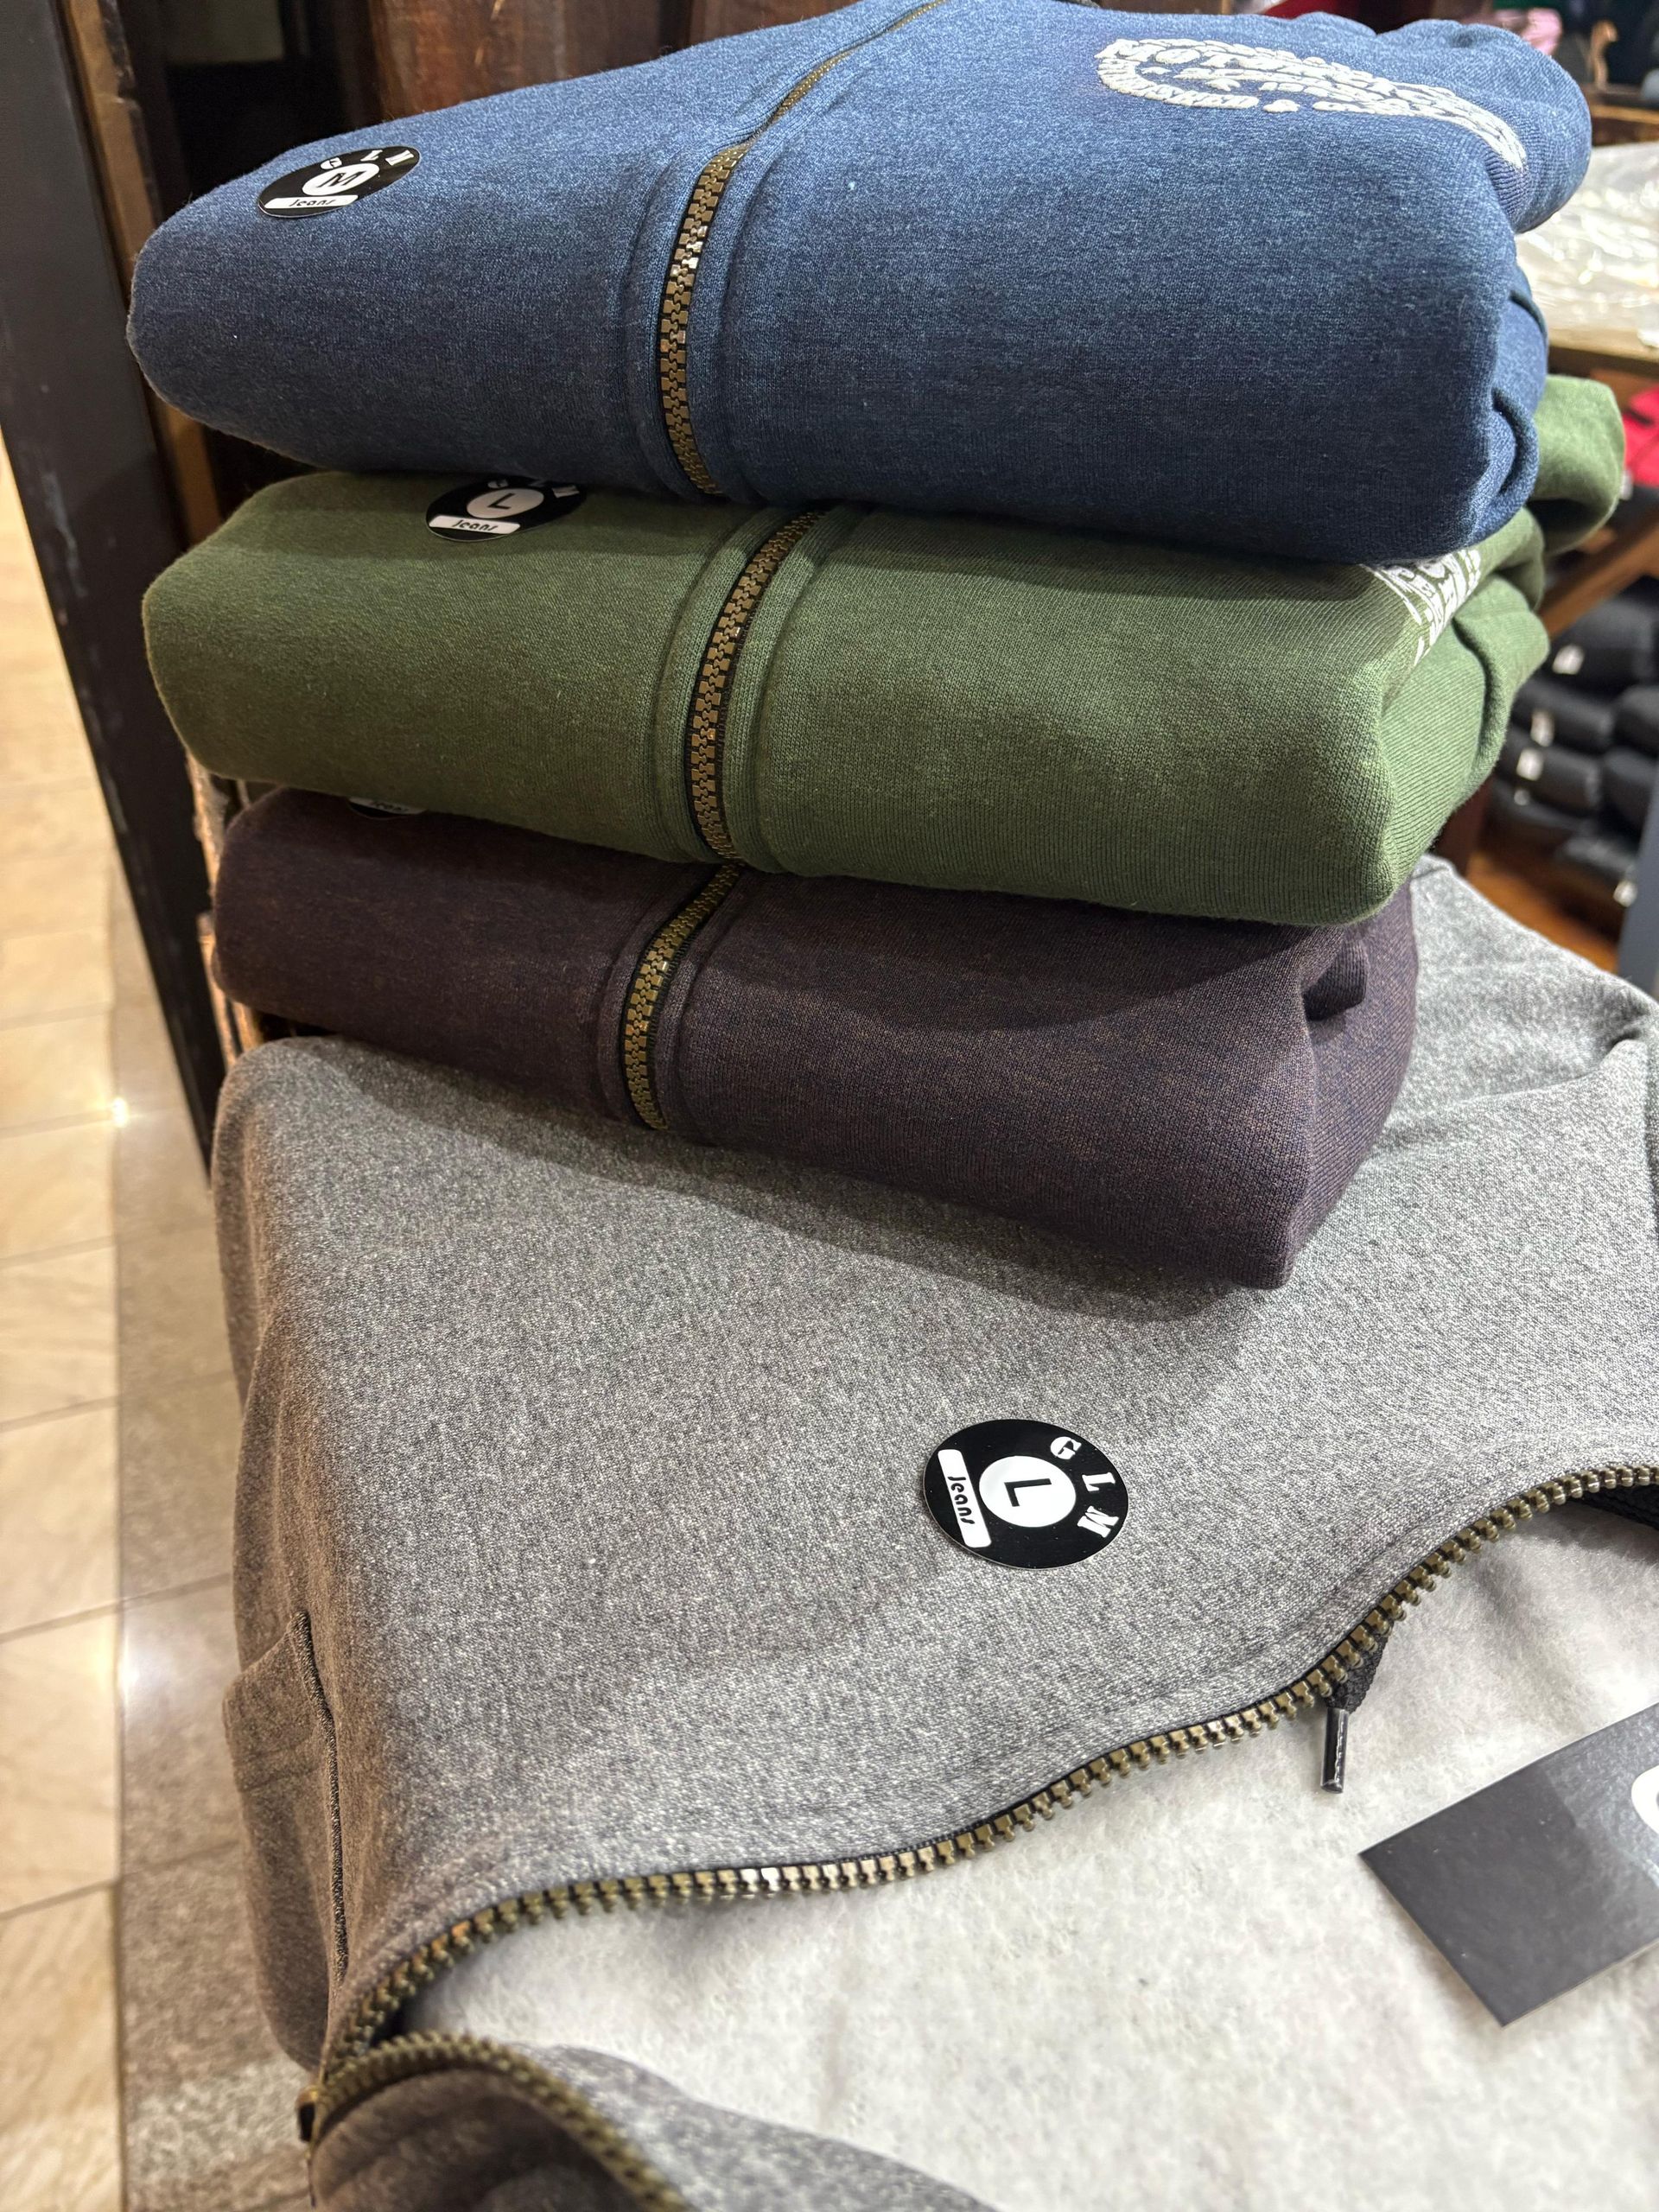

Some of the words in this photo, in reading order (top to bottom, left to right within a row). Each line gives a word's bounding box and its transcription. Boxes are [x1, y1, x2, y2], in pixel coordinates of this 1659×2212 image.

[316, 170, 367, 188] M
[486, 493, 515, 510] L
[947, 1475, 976, 1525] Jeans
[1004, 1478, 1052, 1508] L
